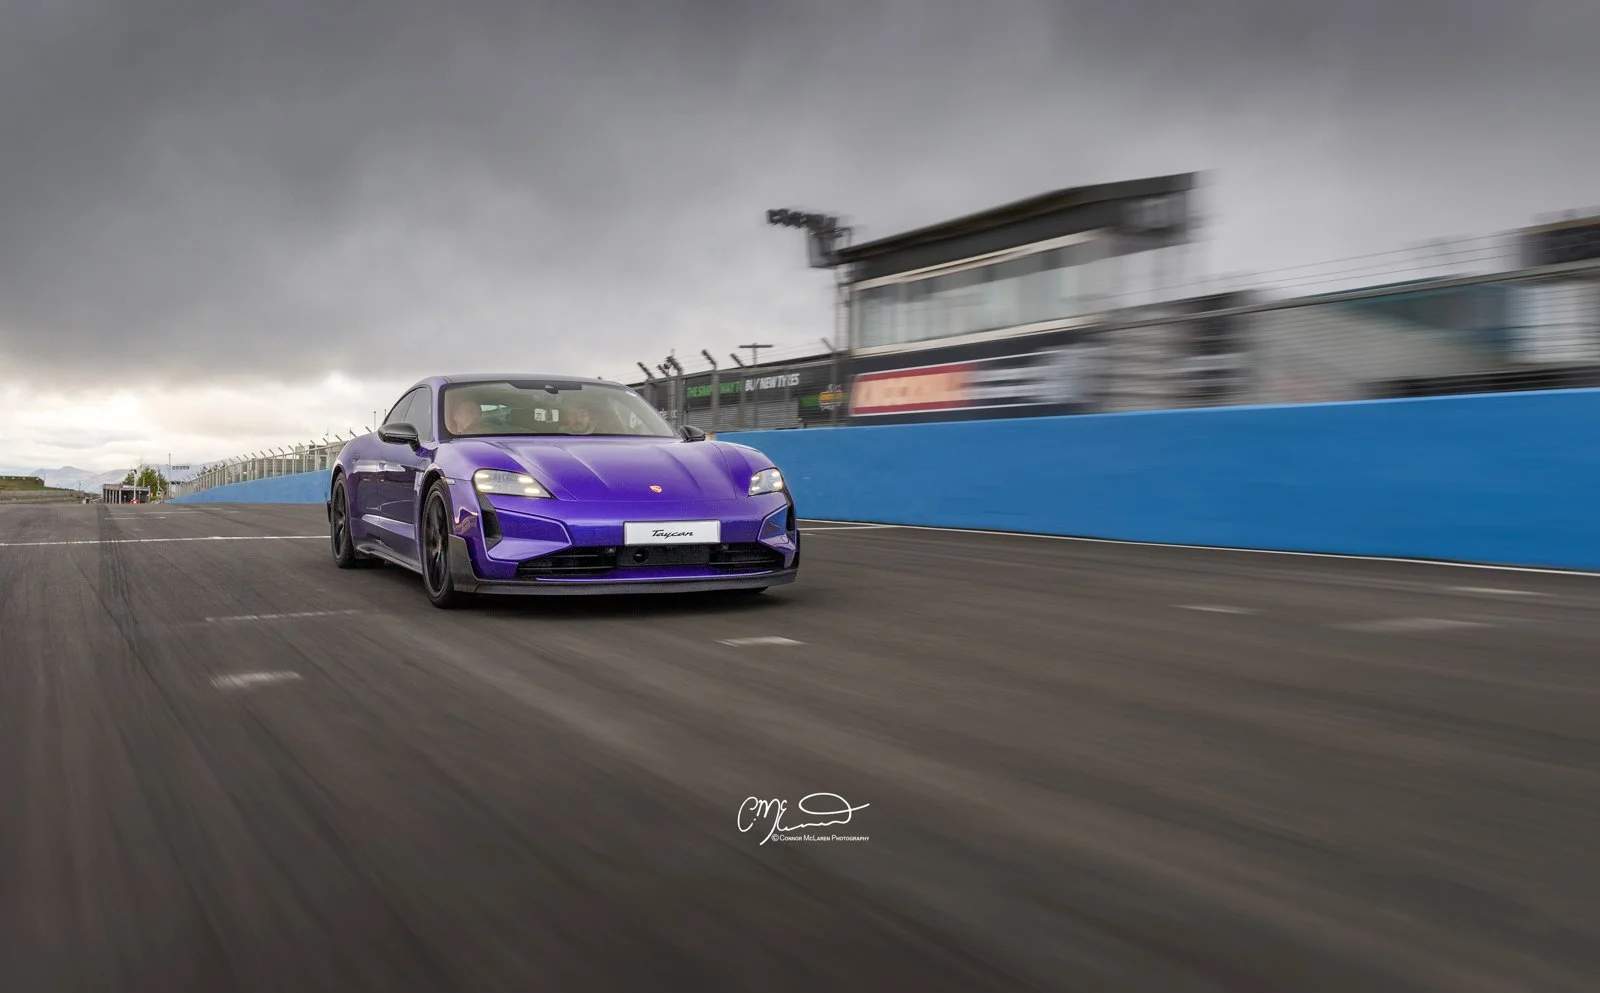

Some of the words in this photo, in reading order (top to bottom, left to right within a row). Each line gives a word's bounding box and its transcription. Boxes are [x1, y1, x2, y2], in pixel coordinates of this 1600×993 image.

[745, 379, 760, 391] BUY
[760, 377, 776, 390] NEW
[652, 529, 694, 539] Taycan
